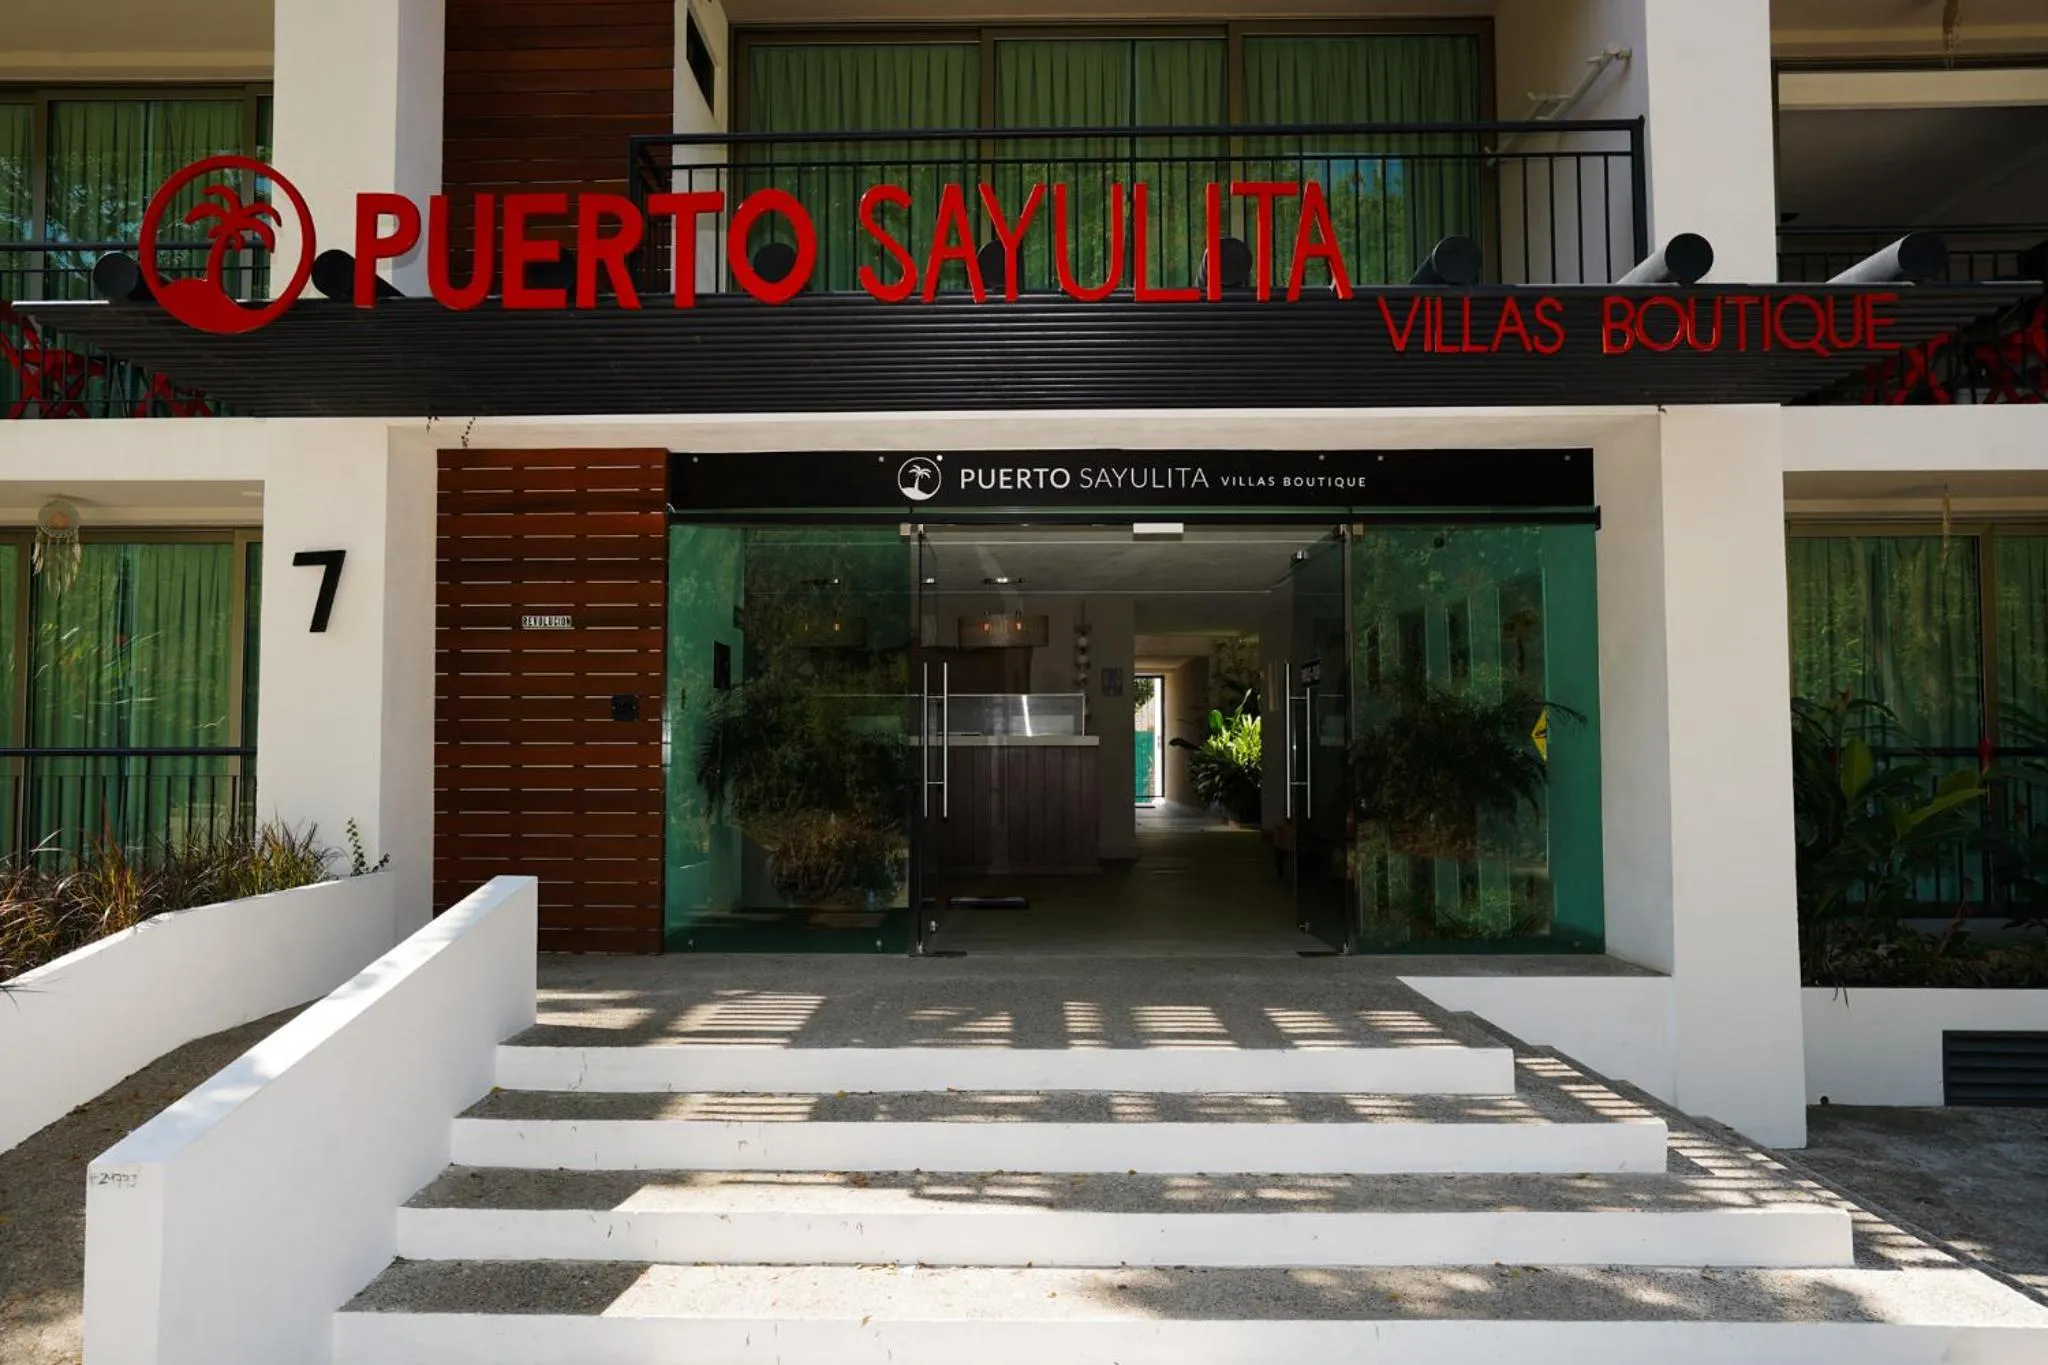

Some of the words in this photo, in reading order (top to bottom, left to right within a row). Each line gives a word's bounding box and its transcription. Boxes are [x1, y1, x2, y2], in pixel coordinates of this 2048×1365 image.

[355, 188, 817, 310] PUERTO
[858, 180, 1353, 304] SAYULITA
[1379, 296, 1564, 354] VILLAS
[1603, 293, 1899, 355] BOUTIQUE
[960, 467, 1071, 490] PUERTO
[1079, 467, 1209, 489] SAYULITA
[1221, 476, 1275, 487] VILLAS
[1283, 476, 1366, 489] BOUTIQUE
[293, 550, 345, 632] 7
